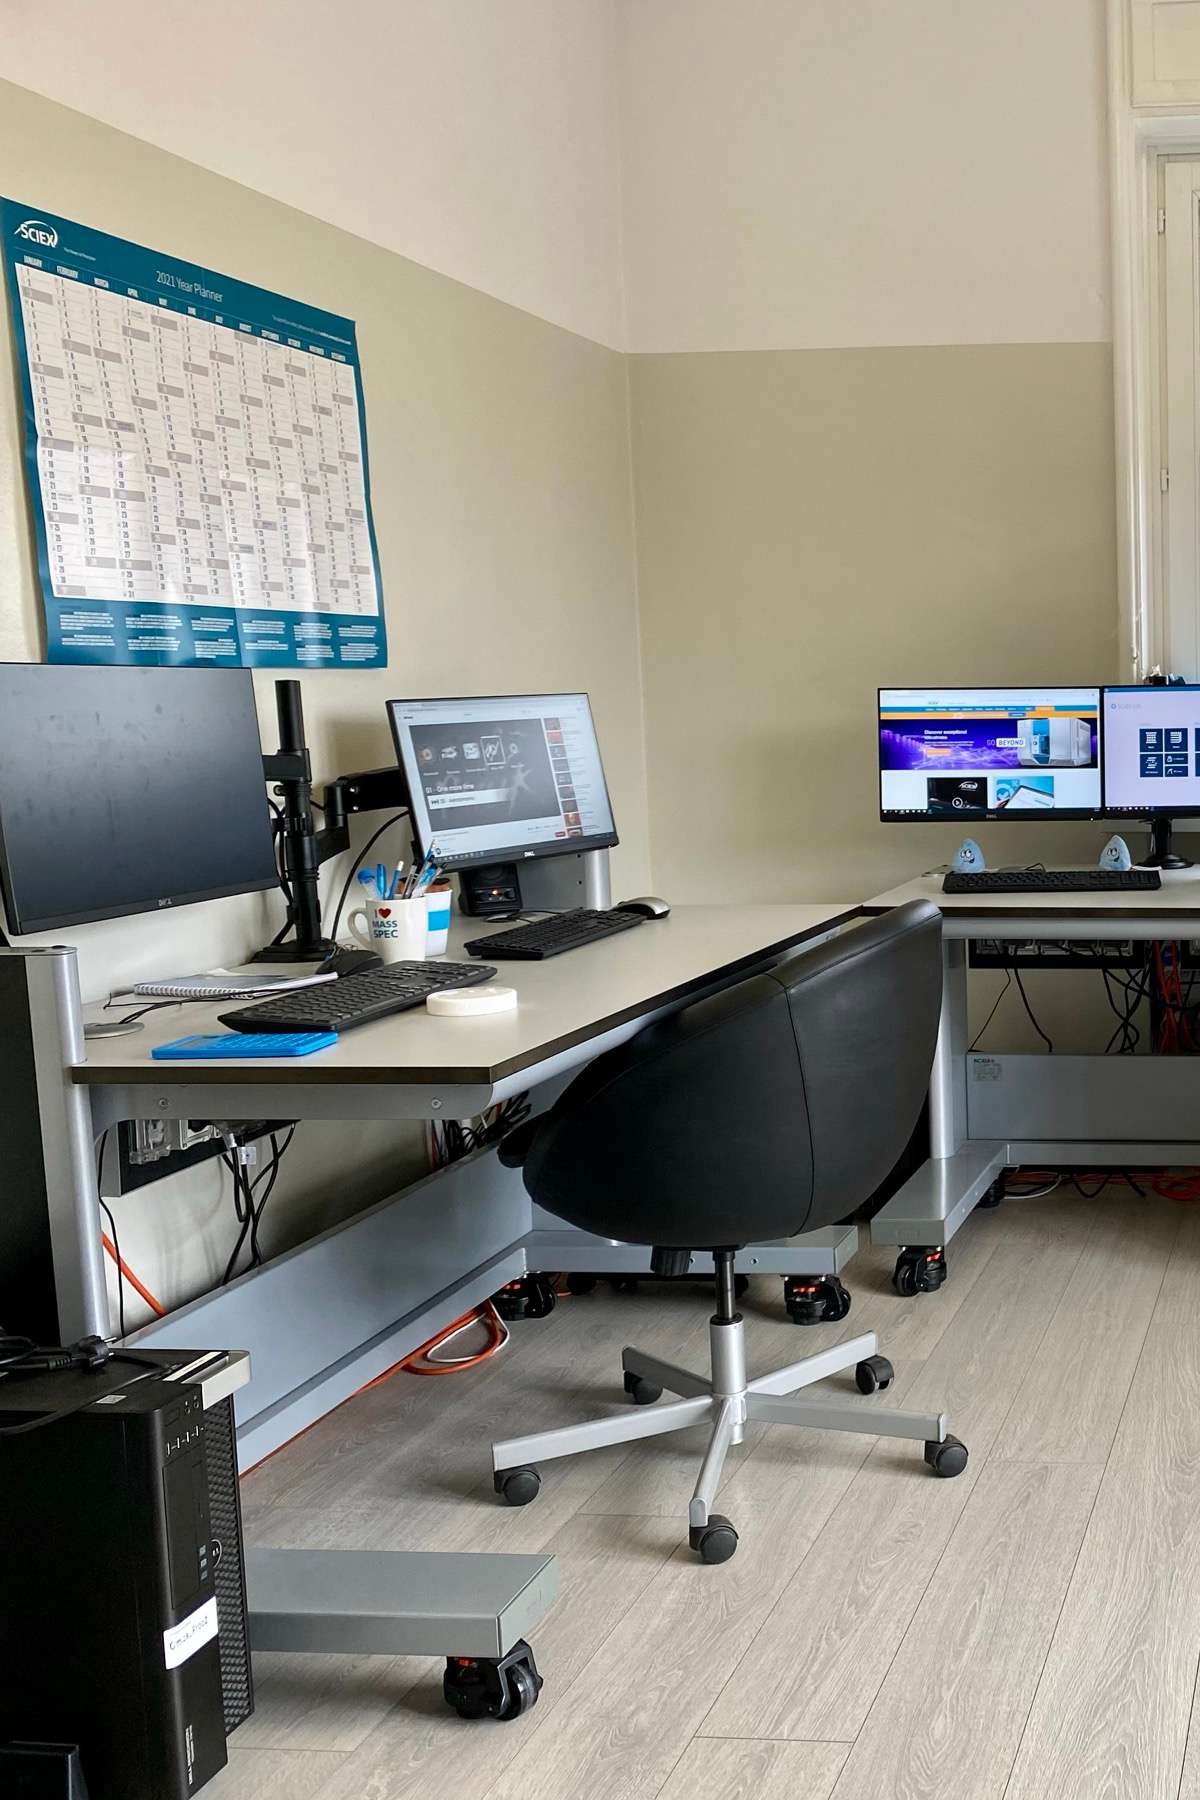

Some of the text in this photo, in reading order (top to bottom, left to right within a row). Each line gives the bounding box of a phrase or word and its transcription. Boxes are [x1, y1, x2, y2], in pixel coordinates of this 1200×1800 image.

[20, 222, 57, 248] SCIEX
[155, 270, 223, 303] 2021 Year Planner
[374, 909, 378, 918] I
[372, 920, 398, 928] MASS
[374, 929, 398, 938] SPEC
